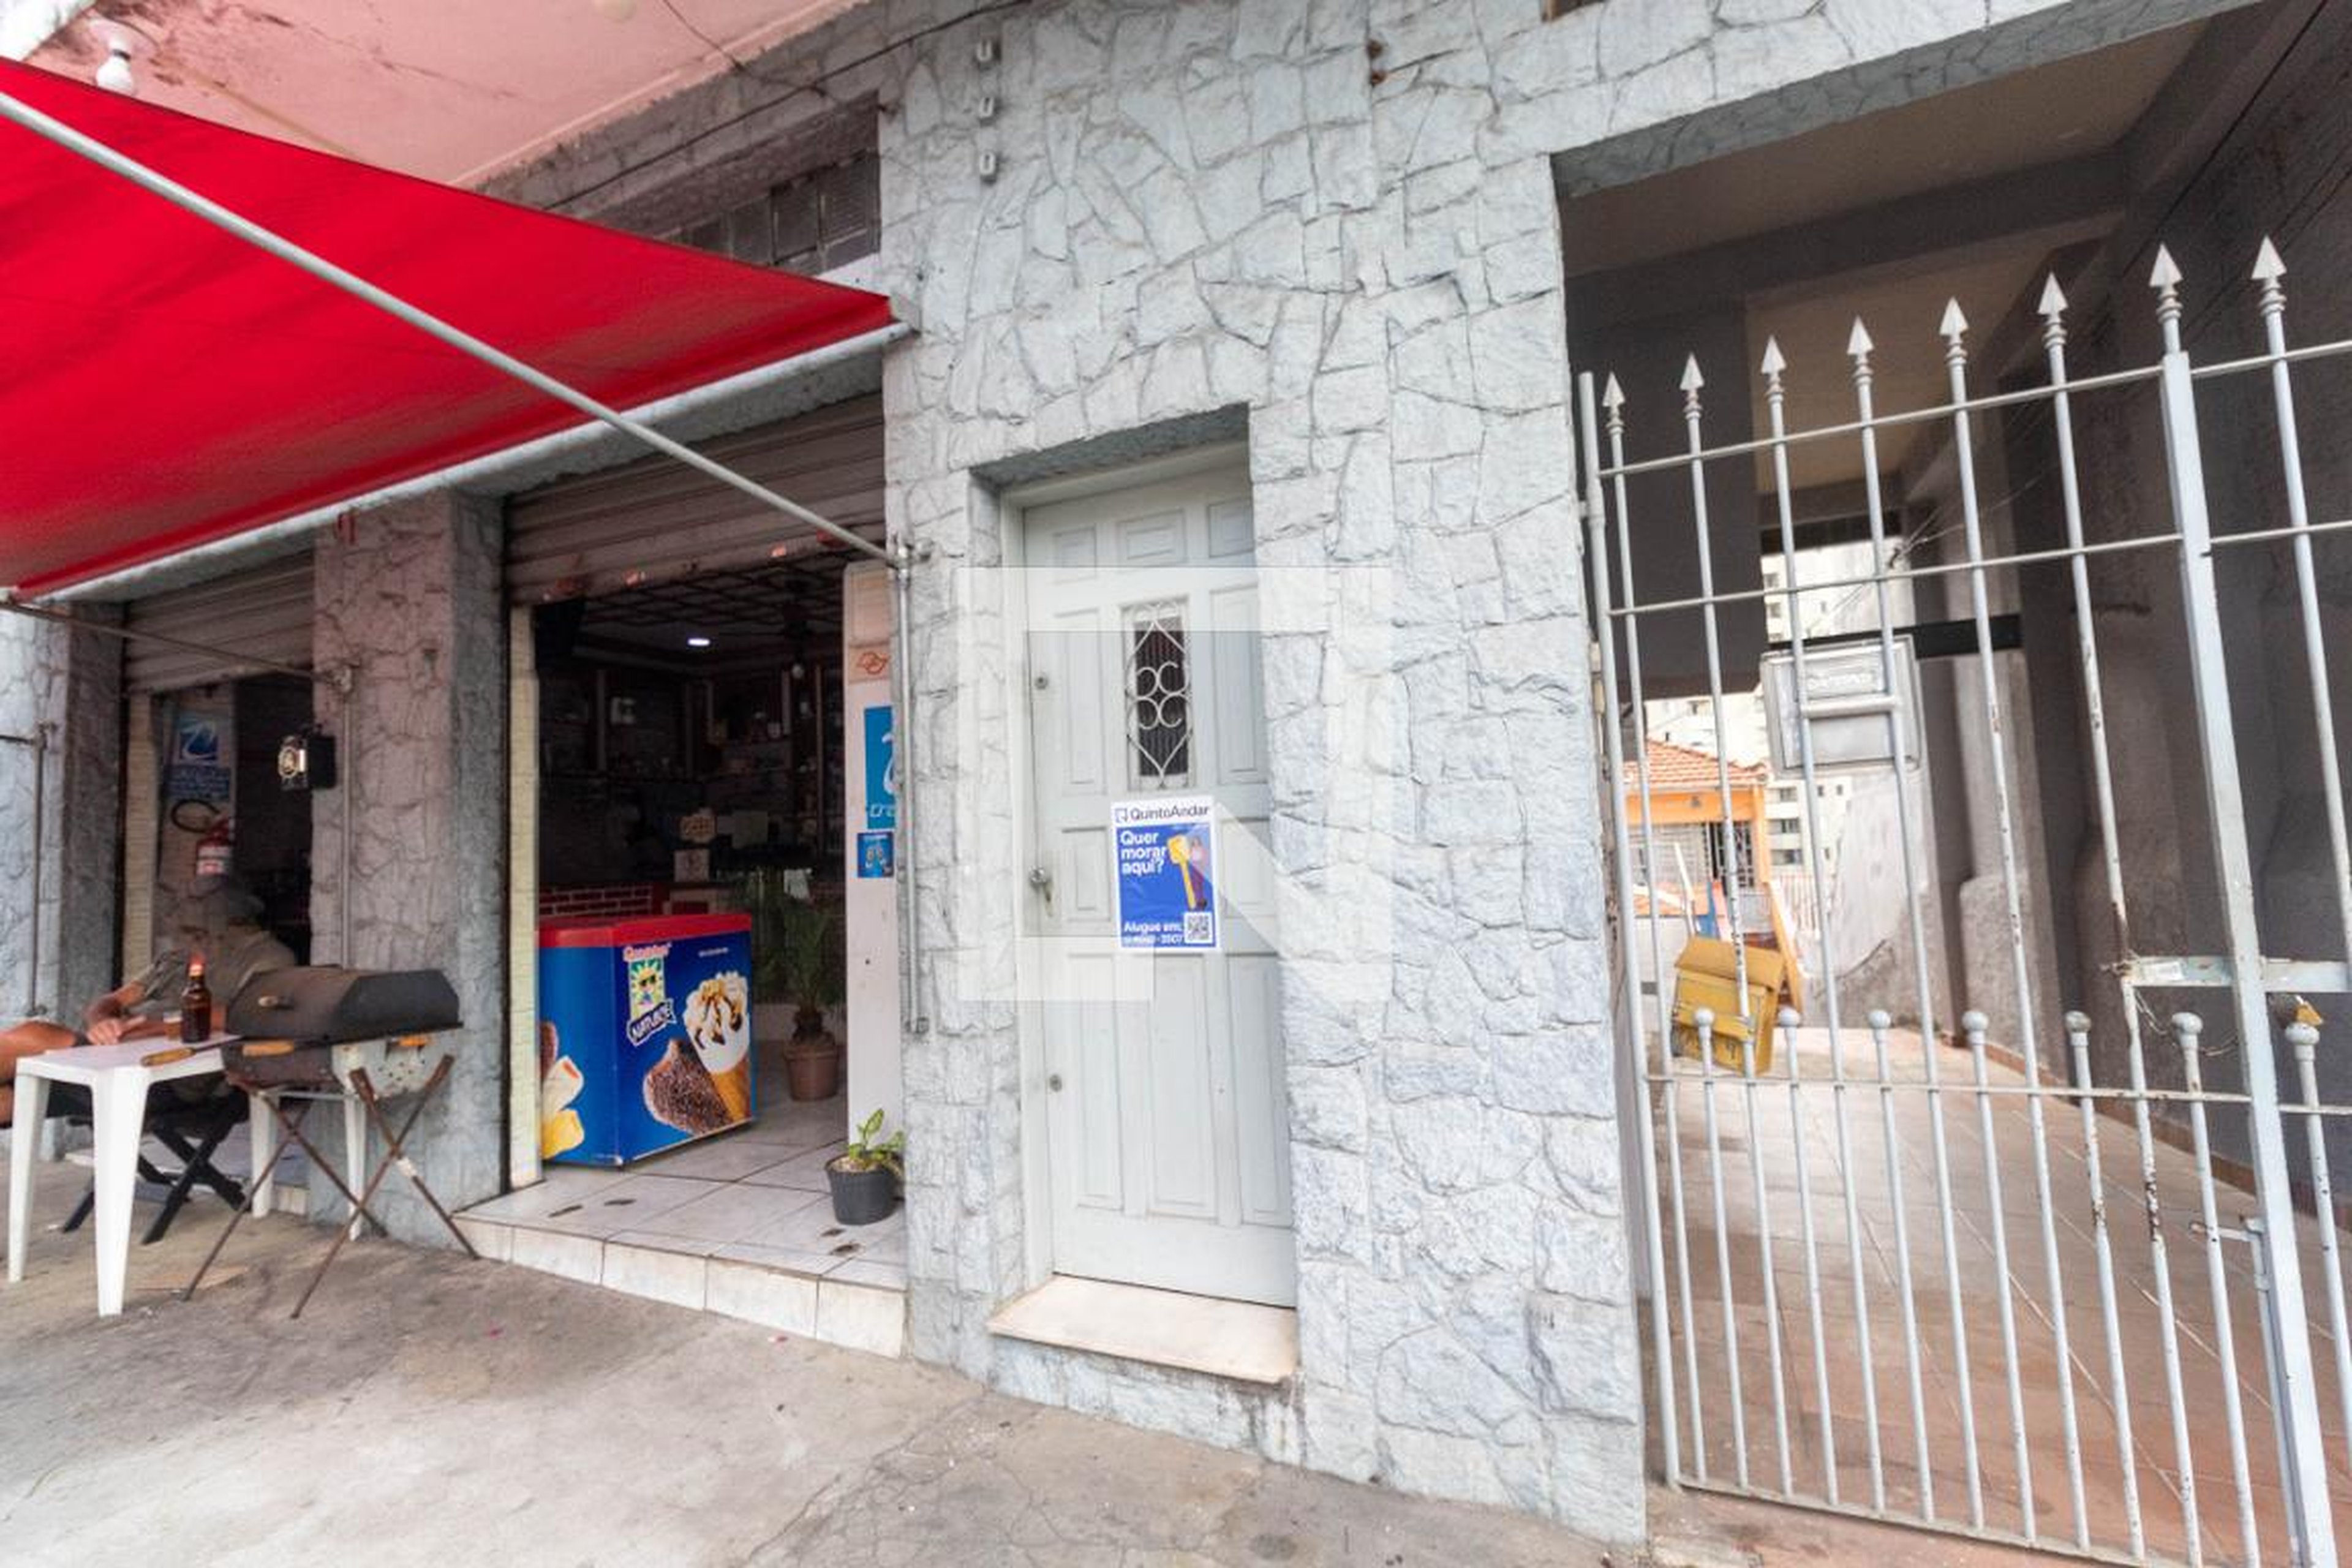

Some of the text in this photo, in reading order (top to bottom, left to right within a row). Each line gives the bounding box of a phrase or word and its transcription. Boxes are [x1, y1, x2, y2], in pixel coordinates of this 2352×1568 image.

[1130, 805, 1208, 820] QuintoAndar
[1120, 830, 1159, 845] Quer
[1121, 846, 1166, 859] morar
[1121, 858, 1164, 876] aqui?
[1124, 921, 1161, 936] Alugue
